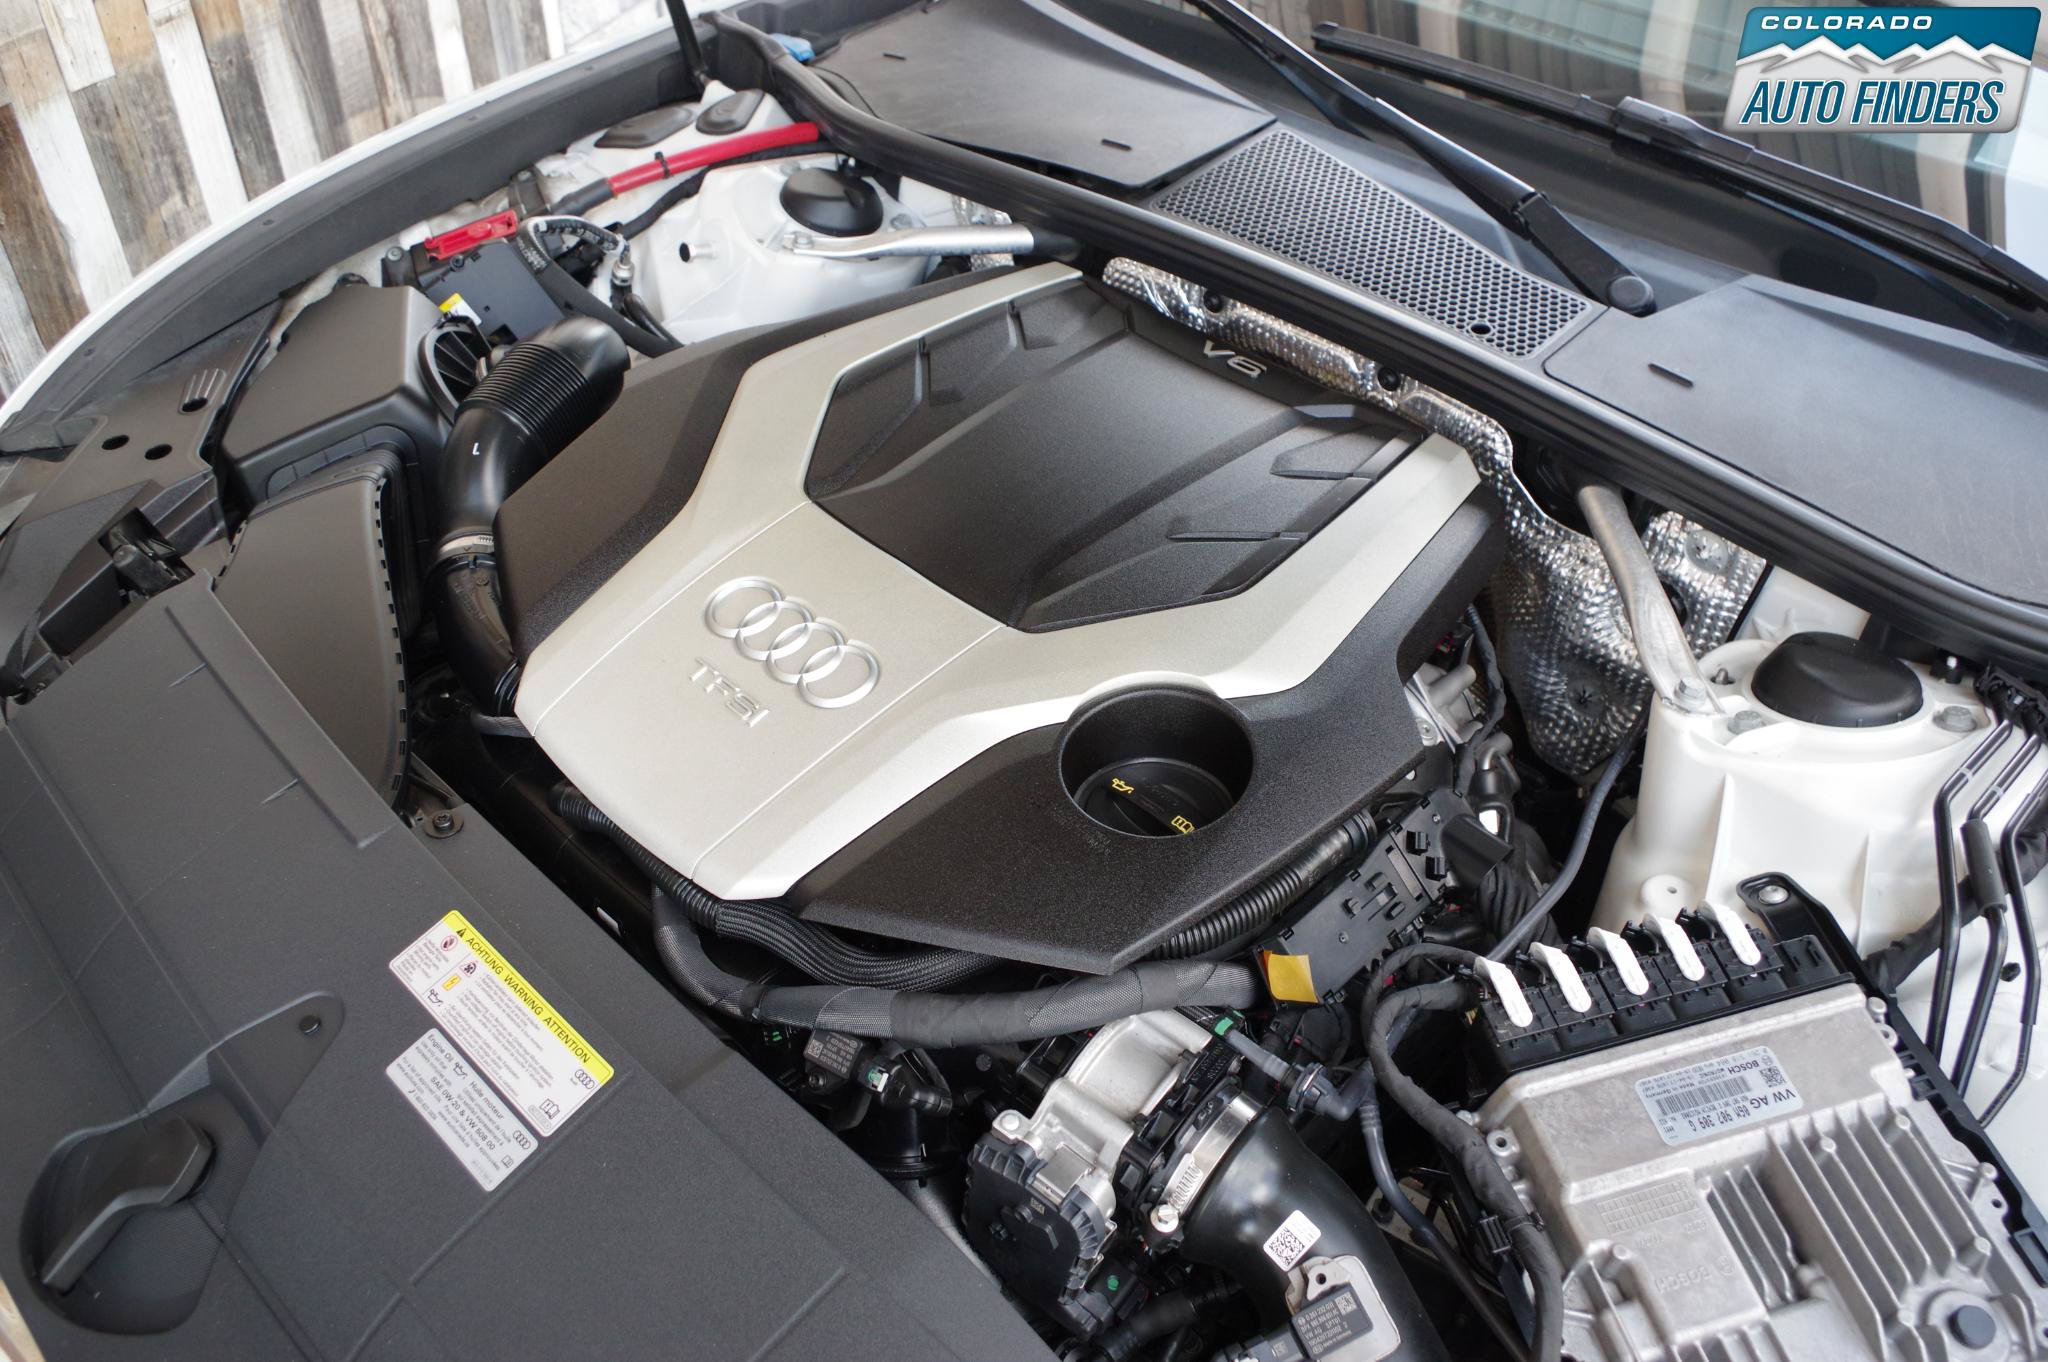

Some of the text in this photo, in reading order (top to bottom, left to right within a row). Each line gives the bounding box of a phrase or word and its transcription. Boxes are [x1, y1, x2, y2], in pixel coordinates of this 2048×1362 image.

[1203, 339, 1268, 379] V6
[689, 657, 770, 728] TFSI
[464, 935, 504, 975] ACHTUNG
[502, 974, 544, 1016] WARNING
[542, 1014, 591, 1064] ATTENTION
[1727, 1059, 1760, 1074] BOSCH
[469, 1080, 505, 1120] Huile moteur
[1749, 1095, 1770, 1110] AG
[1772, 1088, 1797, 1103] VW
[429, 1075, 443, 1090] SAE
[458, 1108, 466, 1116] &
[463, 1114, 477, 1129] VW
[485, 1139, 496, 1150] 00
[1716, 1109, 1733, 1124] 907
[1733, 1103, 1751, 1119] 06M
[1697, 1115, 1715, 1129] 309
